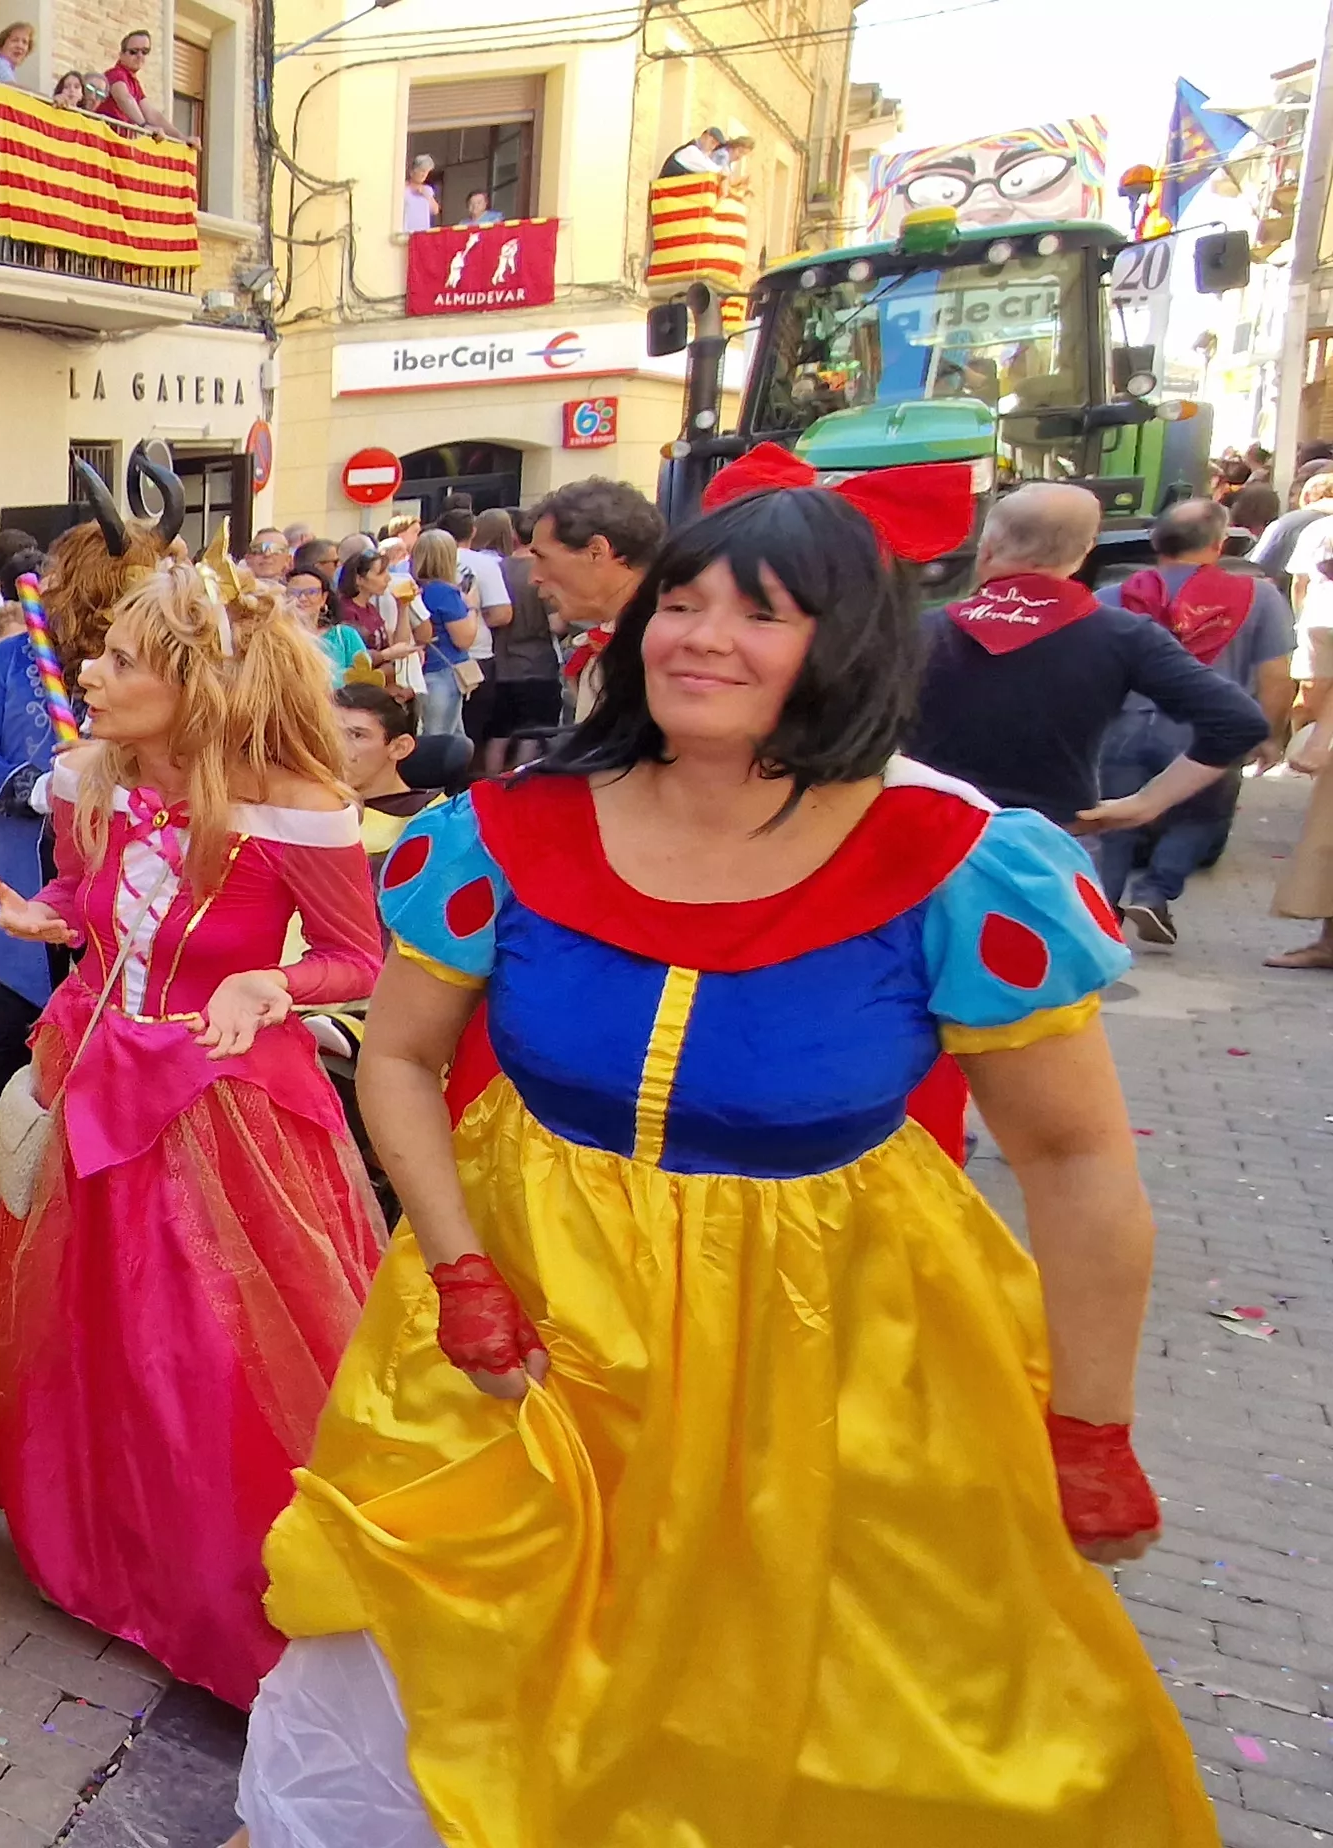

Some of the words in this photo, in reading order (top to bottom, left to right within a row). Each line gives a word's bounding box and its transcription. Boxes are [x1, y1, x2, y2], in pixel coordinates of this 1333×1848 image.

[1114, 242, 1170, 291] 20
[434, 288, 526, 306] ALMUDEVAR
[393, 344, 514, 371] iberCaja
[69, 367, 107, 400] LA
[132, 372, 244, 406] GATERA
